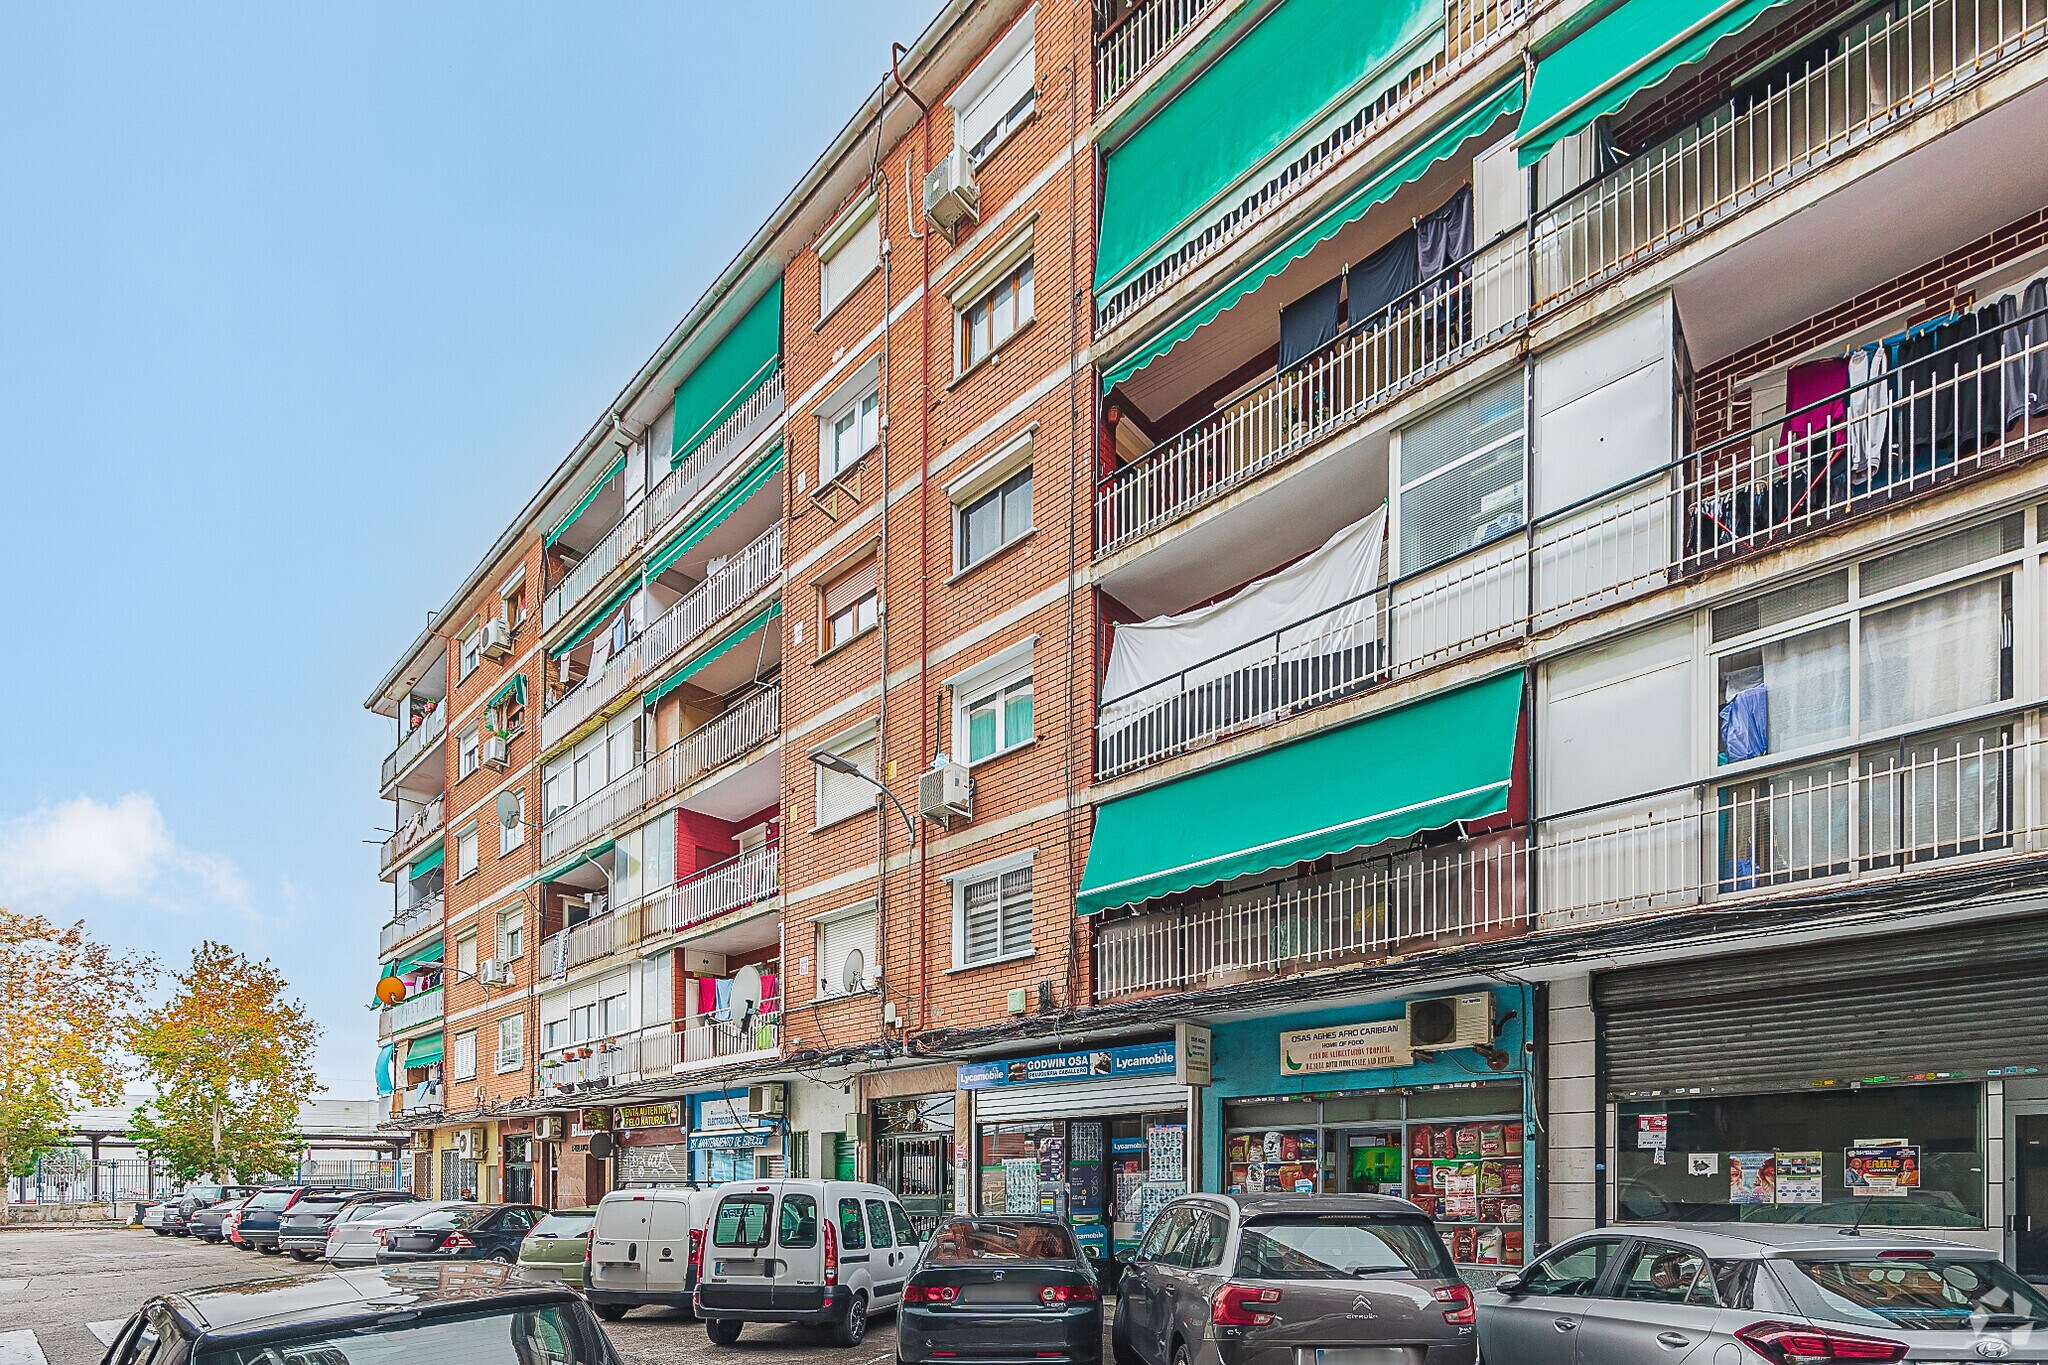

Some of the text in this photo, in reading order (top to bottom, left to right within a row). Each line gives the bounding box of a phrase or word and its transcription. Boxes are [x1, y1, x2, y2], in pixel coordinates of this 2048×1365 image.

[1313, 1032, 1337, 1041] AGHES
[1338, 1029, 1359, 1038] AFRO
[1360, 1025, 1399, 1036] CARIBEAN
[1027, 1055, 1089, 1071] GODWIN OSA
[1116, 1049, 1174, 1069] Lycamobile
[960, 1067, 1004, 1084] Lycamobile
[640, 1115, 667, 1126] NATURAL
[1113, 1140, 1147, 1152] Lycamobile
[1077, 1230, 1104, 1240] camobile
